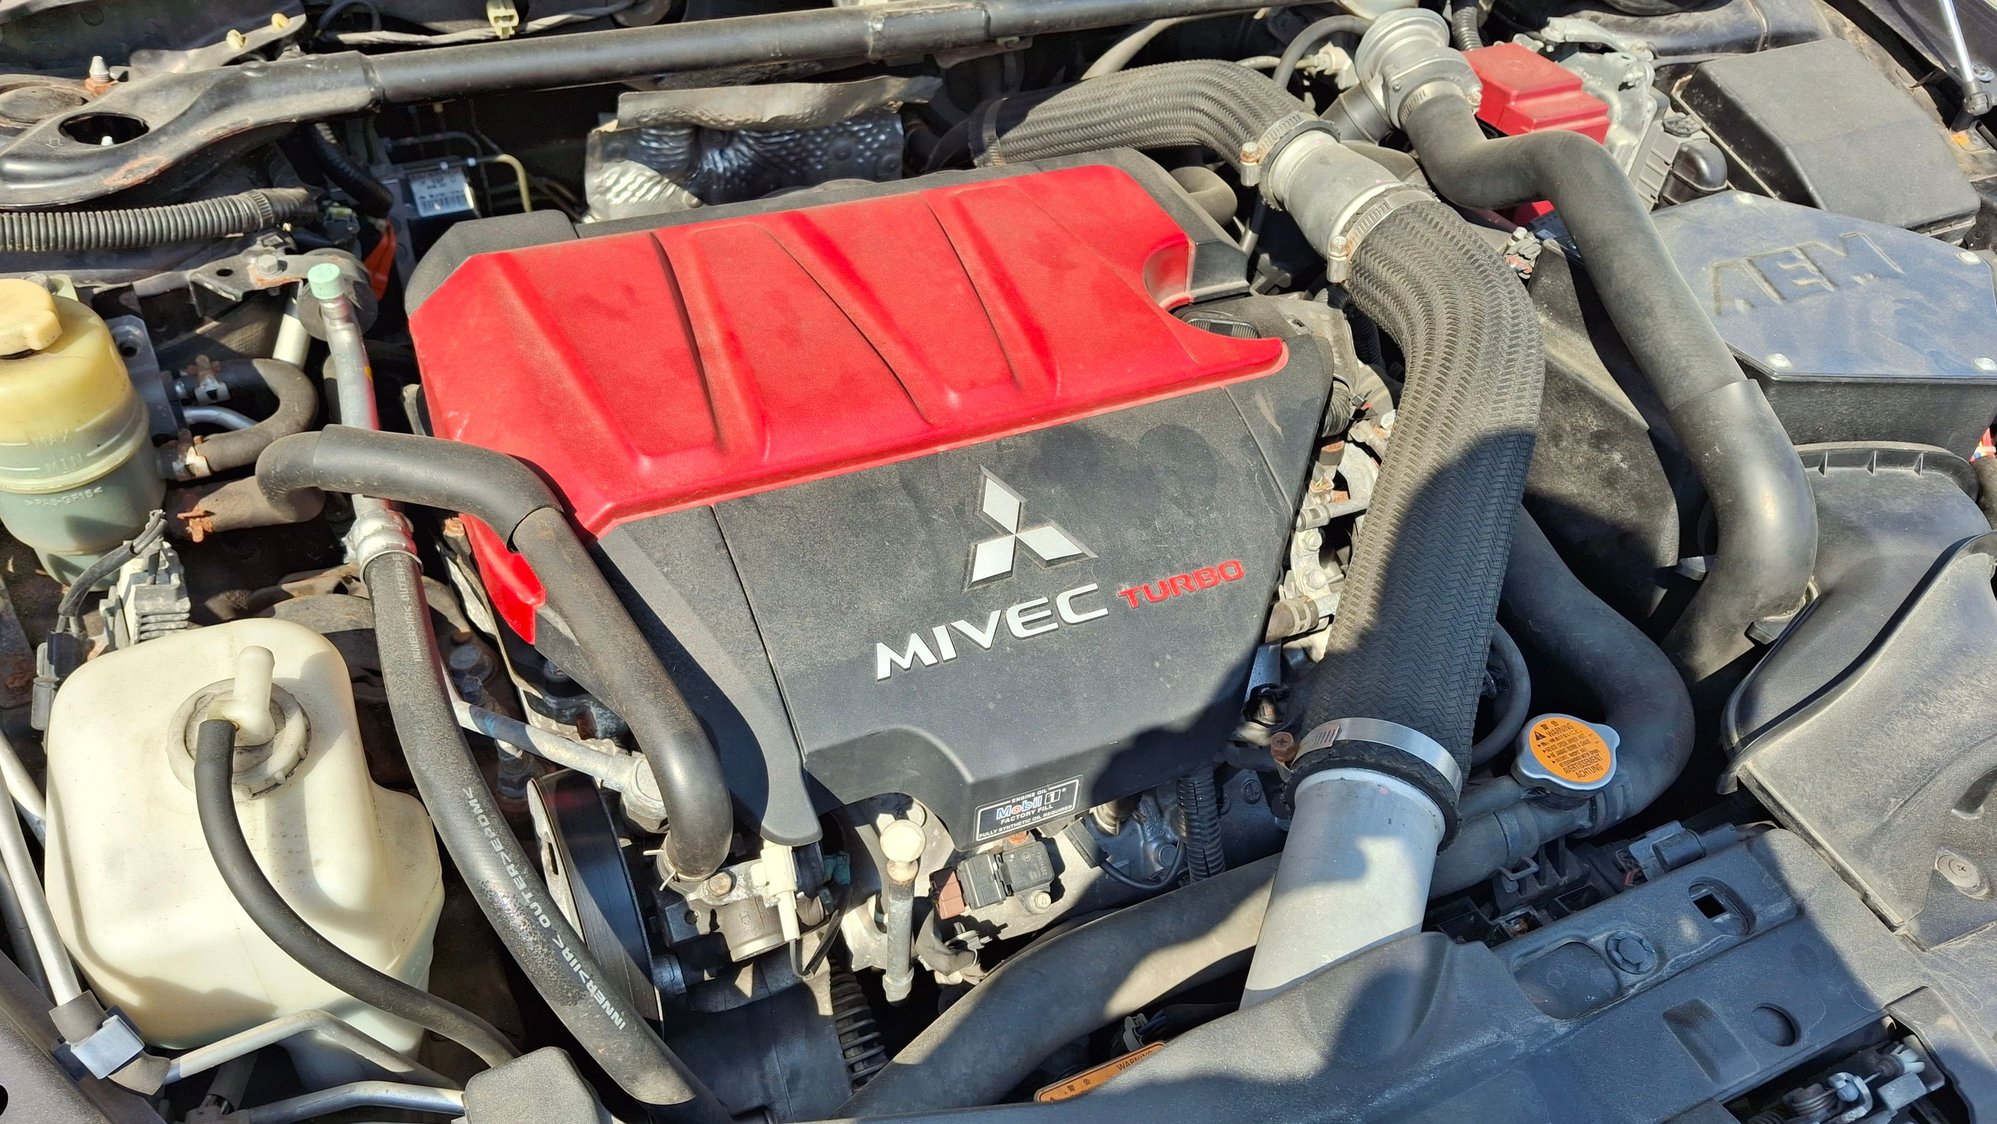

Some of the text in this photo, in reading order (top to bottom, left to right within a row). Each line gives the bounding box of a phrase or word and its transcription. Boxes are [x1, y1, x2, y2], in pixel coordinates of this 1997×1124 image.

[1711, 232, 1904, 316] AEM
[875, 559, 1245, 682] MIVEC TURBO
[1545, 722, 1575, 738] WARNING
[1562, 753, 1604, 774] AVERTISSEMENT
[1575, 763, 1604, 779] ACHTUNG
[996, 794, 1043, 820] Mobil
[1011, 788, 1048, 804] ENGINE OIL
[979, 804, 1073, 838] FULLY SYNTHETIC OIL REQUIRED
[1000, 804, 1054, 825] FACTORY FILL
[463, 786, 627, 1031] INNER>IIR< OUTER>EPDM<
